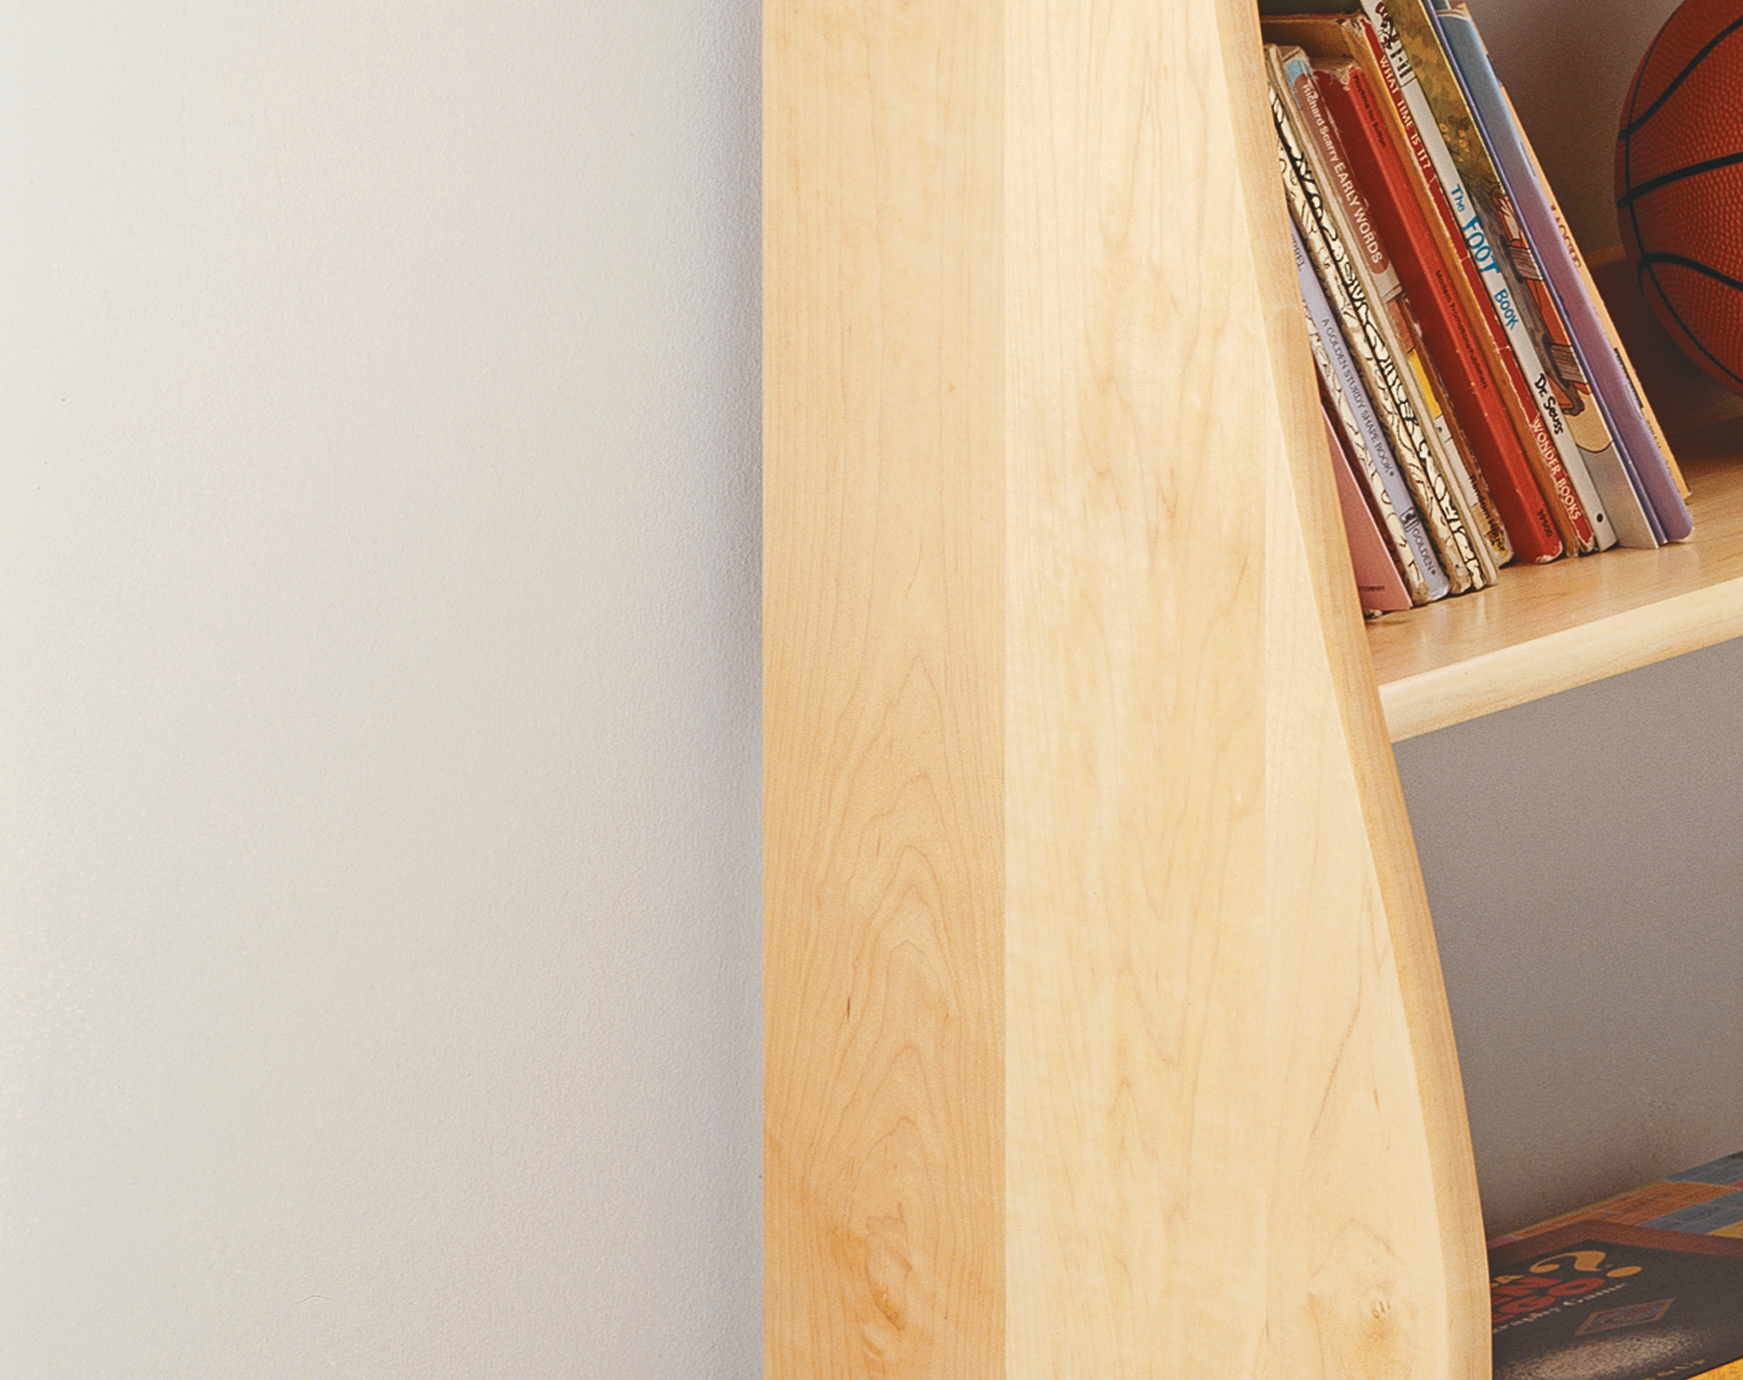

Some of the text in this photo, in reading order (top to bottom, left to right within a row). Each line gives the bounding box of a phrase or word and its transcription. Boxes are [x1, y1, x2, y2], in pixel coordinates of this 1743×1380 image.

[1377, 55, 1431, 169] WHAT TIME IS IT?
[1300, 83, 1384, 264] Richard Scarry EARLY WORDS
[1448, 183, 1469, 212] The
[1457, 214, 1501, 280] FOOT
[1324, 327, 1349, 369] GOLDEN
[1341, 369, 1366, 408] STURDY
[1359, 409, 1381, 443] SHAPE
[1374, 442, 1394, 471] BOOK
[1531, 372, 1567, 435] Dr. Seuss
[1528, 417, 1583, 520] WONDER BOOKS
[1408, 527, 1436, 570] GOLDEN
